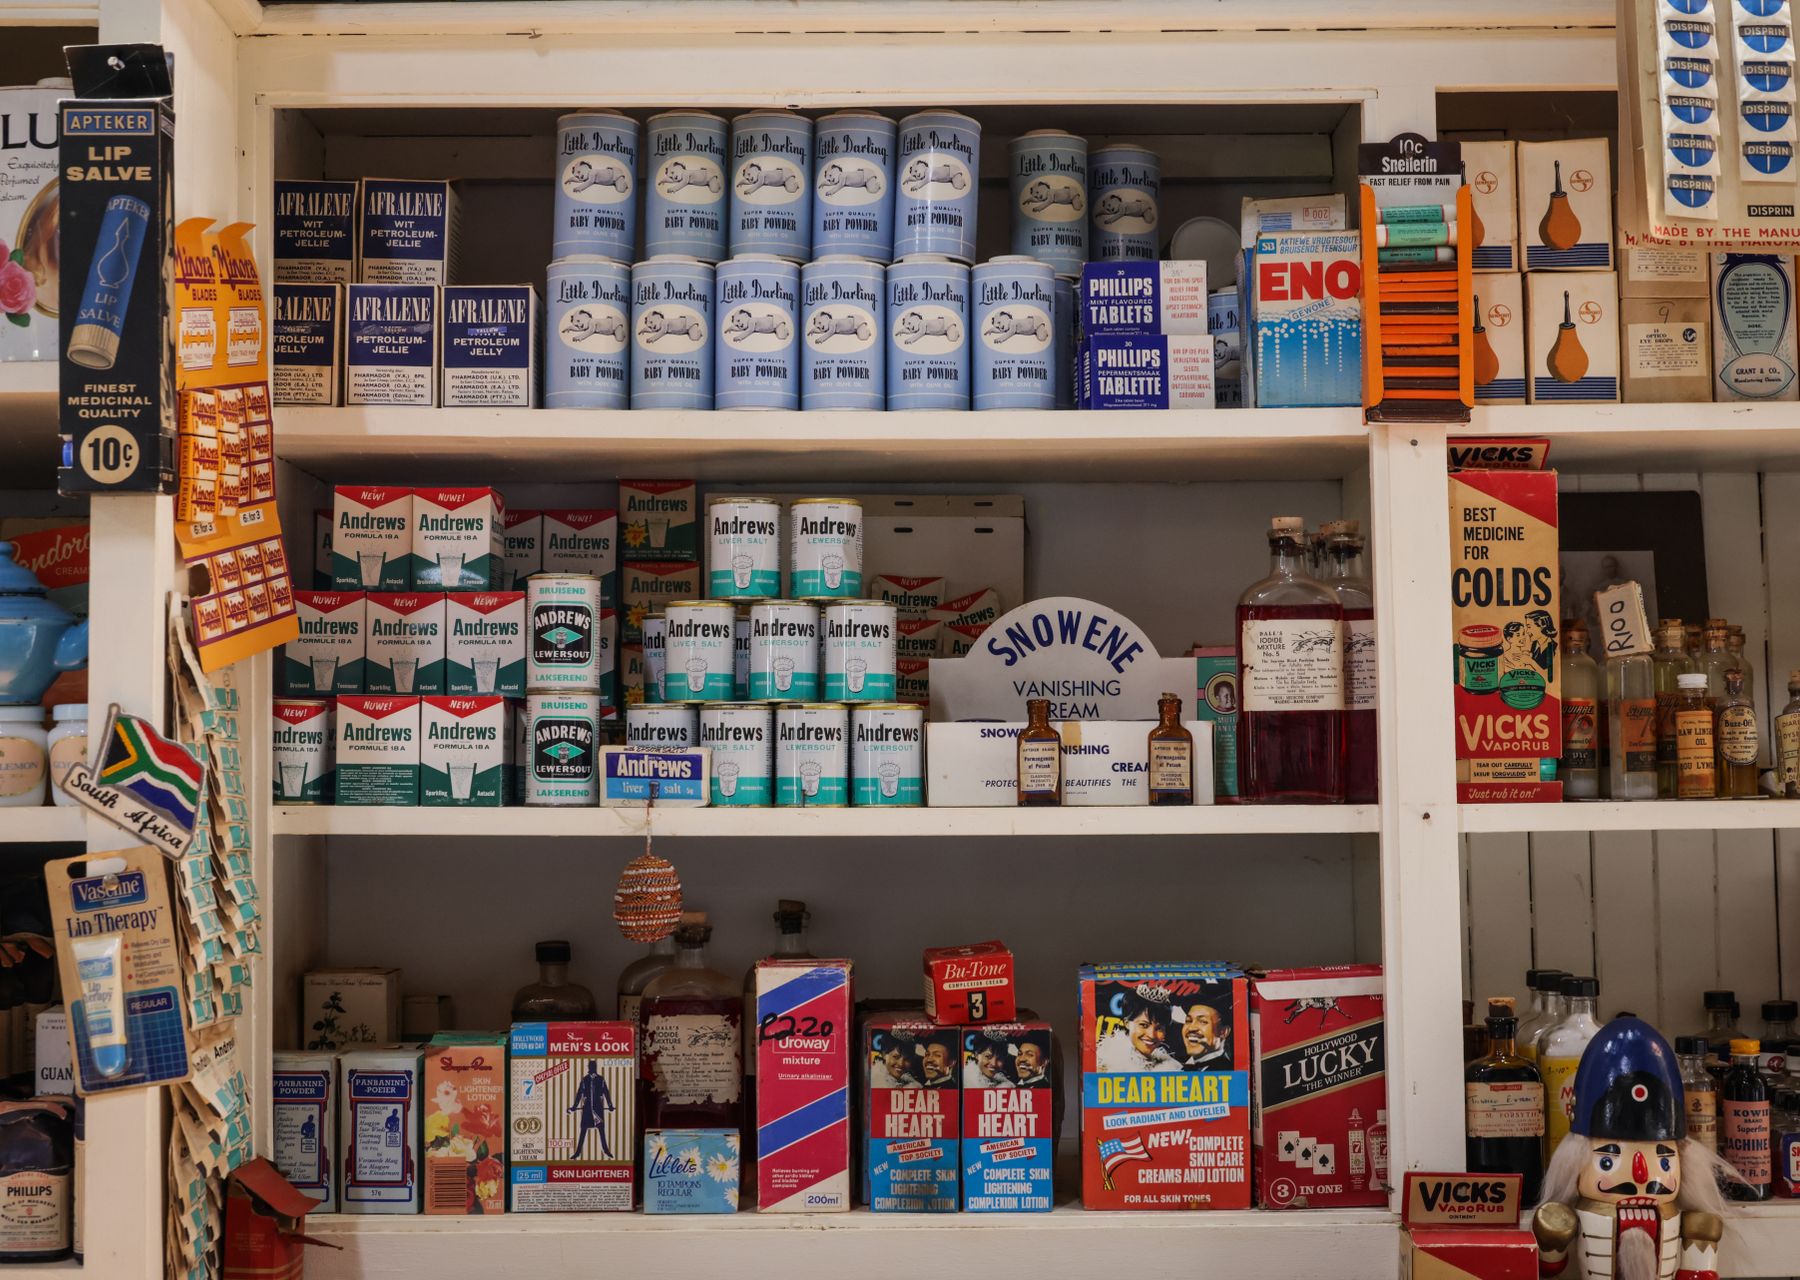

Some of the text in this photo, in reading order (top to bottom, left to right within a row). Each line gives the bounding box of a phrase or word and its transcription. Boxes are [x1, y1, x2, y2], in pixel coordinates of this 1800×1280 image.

[1670, 23, 1710, 33] DISPRIN
[1744, 27, 1786, 36] DISPRIN
[70, 115, 148, 129] APTEKER
[88, 147, 132, 161] LIP
[561, 132, 635, 165] Little Darling
[1382, 156, 1437, 173] Snellerin
[66, 167, 152, 181] SALVE
[1369, 178, 1450, 186] FAST RELIEF FROM PAIN
[368, 192, 442, 216] AFRALENE
[1750, 207, 1792, 216] DISPRIN
[570, 216, 625, 231] BABY POWDER
[370, 230, 438, 238] PETROLEUM-
[1654, 225, 1688, 237] MADE
[1697, 228, 1714, 238] BY
[1722, 228, 1750, 238] THE
[386, 240, 421, 248] JELLIE
[1280, 238, 1309, 246] AKTIEWE
[1280, 245, 1319, 254] BRUISENDE
[1090, 278, 1152, 297] PHILLIPS
[1260, 260, 1361, 302] ENO
[95, 292, 118, 306] LIP
[192, 289, 217, 301] BLADES
[720, 279, 796, 311] Little Darling
[448, 299, 526, 323] AFRALENE
[1091, 306, 1153, 324] TABLETS
[1292, 299, 1330, 319] GEWONE
[80, 308, 121, 328] SALVE
[453, 338, 520, 346] PETROLEUM
[469, 348, 503, 356] JELLY
[1098, 349, 1160, 367] PHILLIPS
[731, 365, 787, 379] BABY POWDER
[84, 384, 137, 393] FINEST
[1098, 377, 1161, 395] TABLETTE
[68, 396, 152, 405] MEDICINAL
[79, 409, 141, 418] QUALITY
[361, 492, 385, 501] NEW!
[438, 493, 465, 502] NUWE!
[340, 512, 405, 530] Andrews
[1464, 508, 1496, 521] BEST
[419, 514, 483, 531] Andrews
[714, 516, 775, 536] Andrews
[800, 517, 856, 537] Andrews
[1464, 527, 1524, 541] MEDICINE
[1464, 546, 1489, 560] FOR
[539, 587, 585, 595] BRUISEND
[1452, 567, 1552, 607] COLDS
[372, 618, 438, 636] Andrews
[535, 611, 591, 631] ANDREWS
[987, 610, 1144, 674] SNOWENE
[535, 650, 590, 659] LEWERSOUT
[1013, 680, 1121, 697] VANISHING
[1049, 702, 1100, 718] REAM
[344, 722, 411, 741] Andrews
[1459, 714, 1550, 751] VICKS
[617, 754, 691, 778] Andrews
[622, 782, 681, 793] liver salt
[1065, 779, 1137, 787] BEAUTIFIES THE
[1492, 788, 1508, 799] rub
[1510, 789, 1518, 798] it
[71, 772, 183, 849] South Africa
[94, 909, 157, 935] Therapy
[944, 960, 1007, 980] Bu-Tone
[948, 979, 1004, 989] COMPLEXION CREAM
[131, 997, 167, 1011] REGULAR
[971, 992, 984, 1020] 3
[550, 1042, 630, 1052] MEN'S LOOK
[779, 1037, 830, 1051] Uroway
[1304, 1032, 1357, 1057] HOLLYWOOD
[783, 1056, 821, 1065] mixture
[1283, 1037, 1379, 1088] LUCKY
[355, 1079, 406, 1087] PANBANINE
[1098, 1075, 1232, 1104] DEAR HEART
[983, 1090, 1033, 1113] DEAR
[1106, 1106, 1226, 1129] LOOK RADIANT AND LOVELIER
[978, 1114, 1038, 1138] HEART
[1147, 1129, 1244, 1151] NEW! COMPLETE
[1190, 1152, 1244, 1167] SKIN CARE
[553, 1170, 630, 1179] SKIN LIGHTENER
[1138, 1168, 1244, 1184] CREAMS AND LOTION
[7, 1186, 52, 1197] PHILLIPS
[665, 1180, 701, 1189] TAMPONS
[1277, 1184, 1343, 1198] 3 IN ONE
[658, 1188, 692, 1197] REGULAR
[808, 1194, 839, 1205] 200ml
[1419, 1182, 1506, 1212] VICKS
